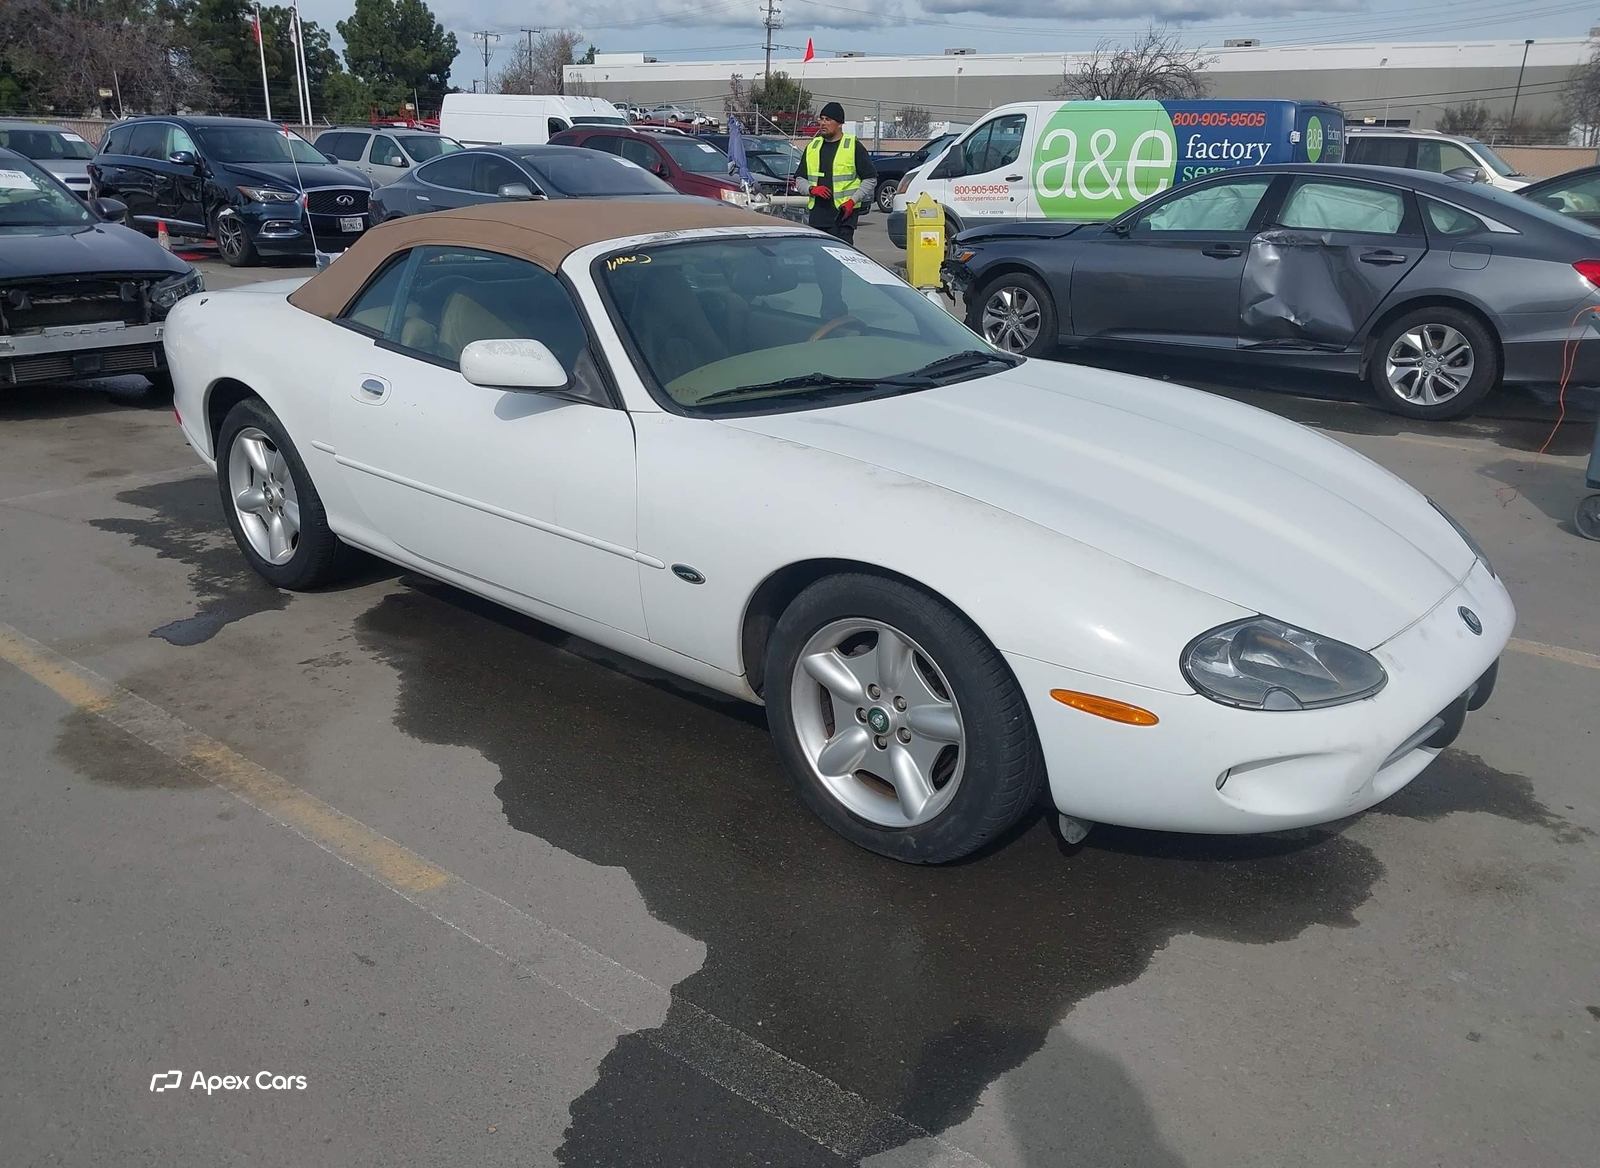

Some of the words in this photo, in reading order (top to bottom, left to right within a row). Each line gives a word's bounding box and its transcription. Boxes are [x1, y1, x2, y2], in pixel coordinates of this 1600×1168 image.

[1185, 133, 1272, 166] factory
[1307, 128, 1323, 150] a&e
[1036, 128, 1172, 201] a&e
